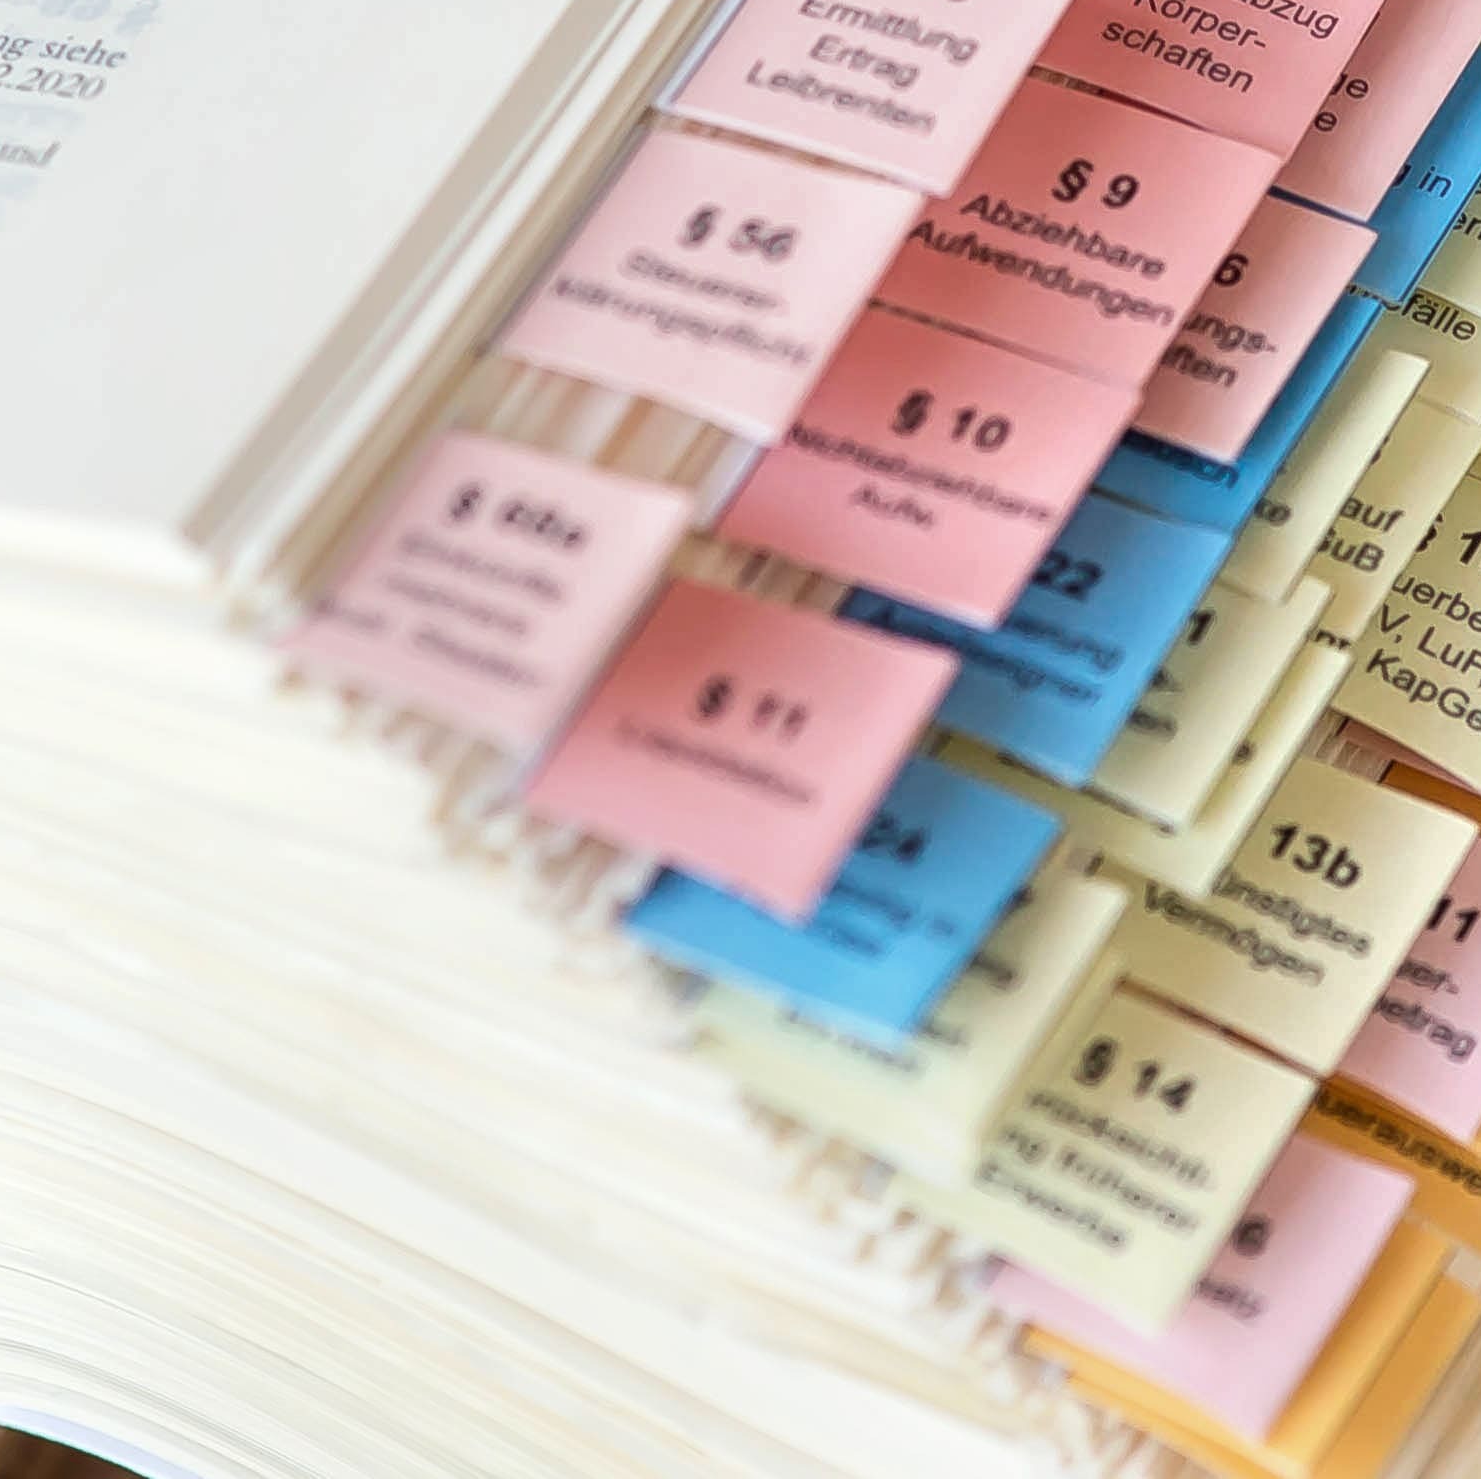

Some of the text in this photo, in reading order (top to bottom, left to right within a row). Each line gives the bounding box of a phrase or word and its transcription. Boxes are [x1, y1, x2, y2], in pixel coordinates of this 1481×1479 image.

[38, 39, 130, 71] siehe
[810, 35, 921, 88] Ertrag
[1102, 21, 1254, 94] schaften
[747, 61, 937, 133] Leibrenten
[1052, 159, 1141, 210] § 9
[961, 192, 1166, 279] Abziehbare
[912, 219, 1175, 325] Aufwendungen
[950, 406, 1011, 452] 10
[1268, 823, 1362, 890] 13b
[1132, 1057, 1194, 1114] 14
